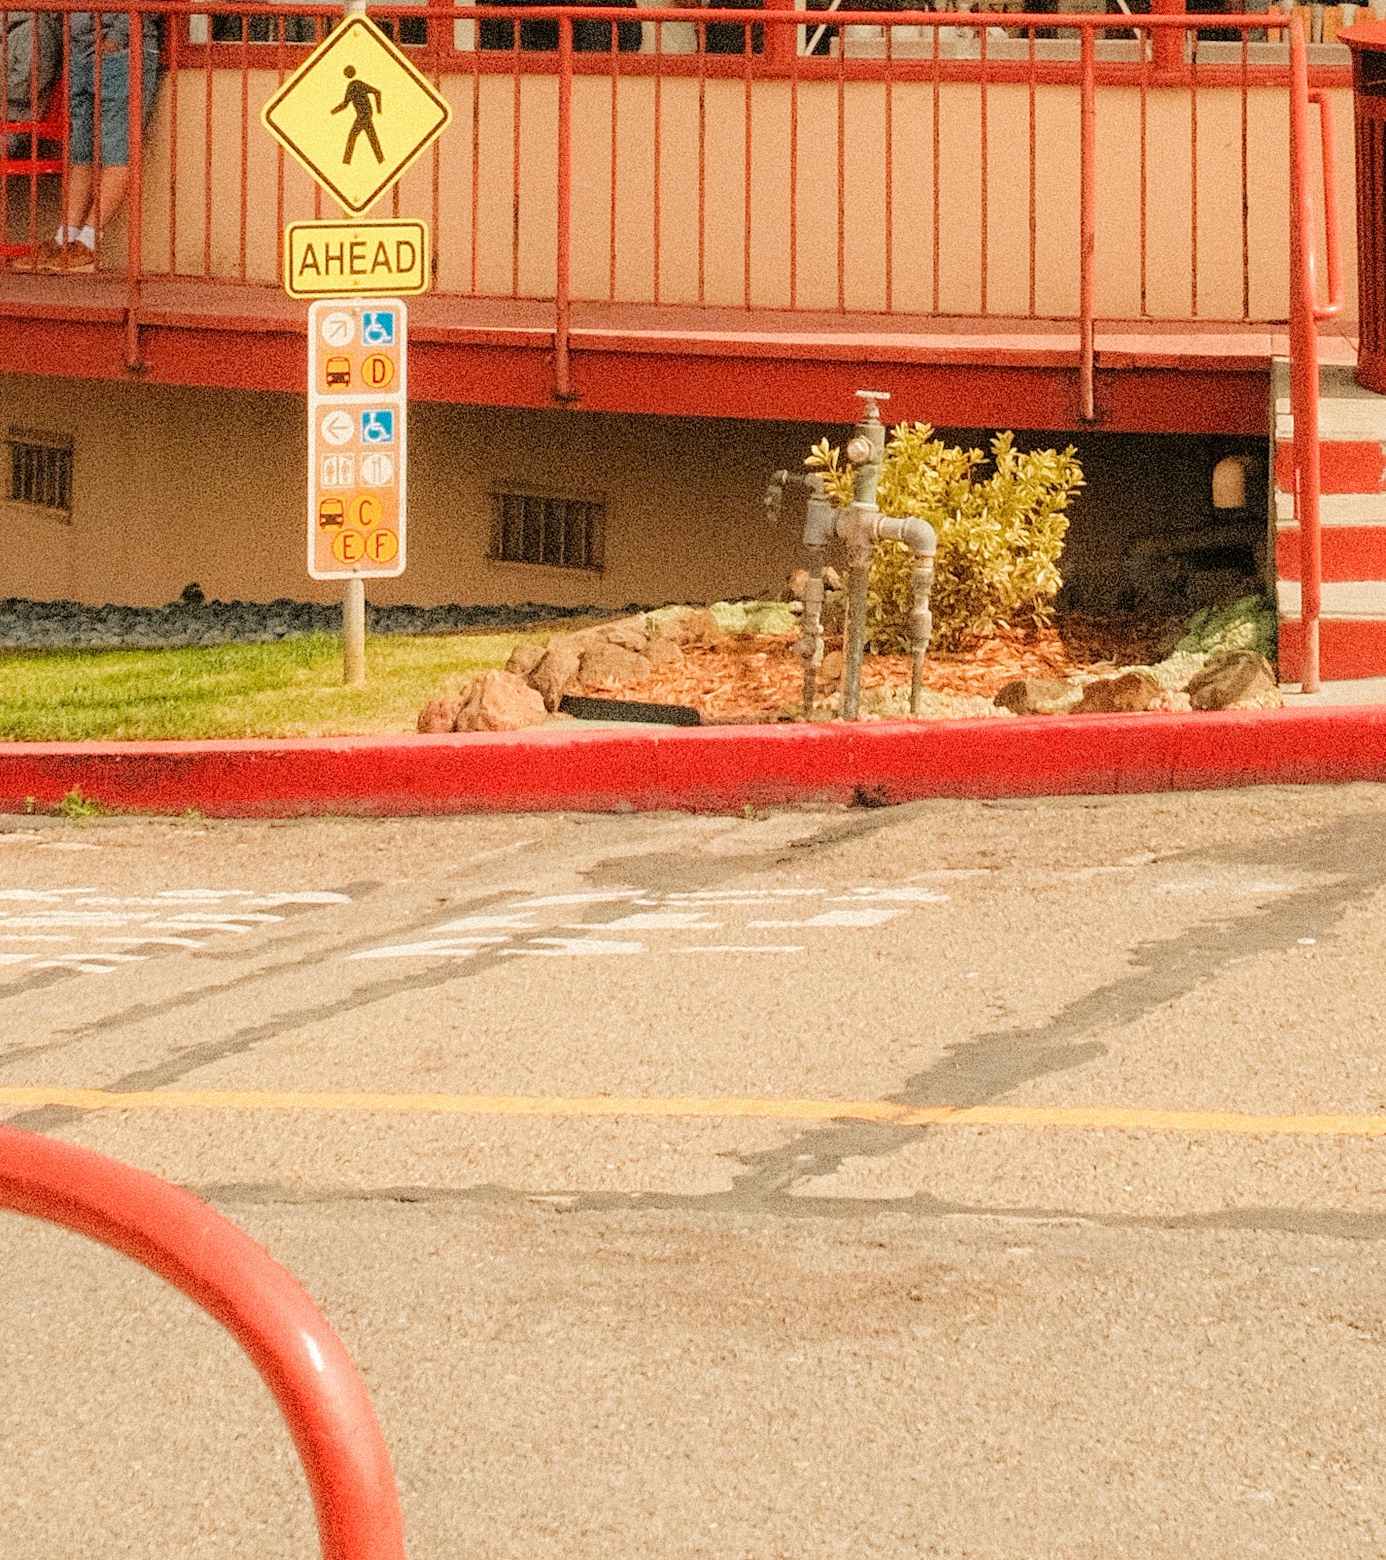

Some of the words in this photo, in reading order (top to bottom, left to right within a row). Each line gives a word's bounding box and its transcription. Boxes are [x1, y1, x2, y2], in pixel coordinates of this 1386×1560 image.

[297, 240, 417, 278] AHEAD
[373, 358, 386, 384] D
[359, 499, 373, 526] C
[343, 534, 356, 560] E
[375, 533, 389, 559] F
